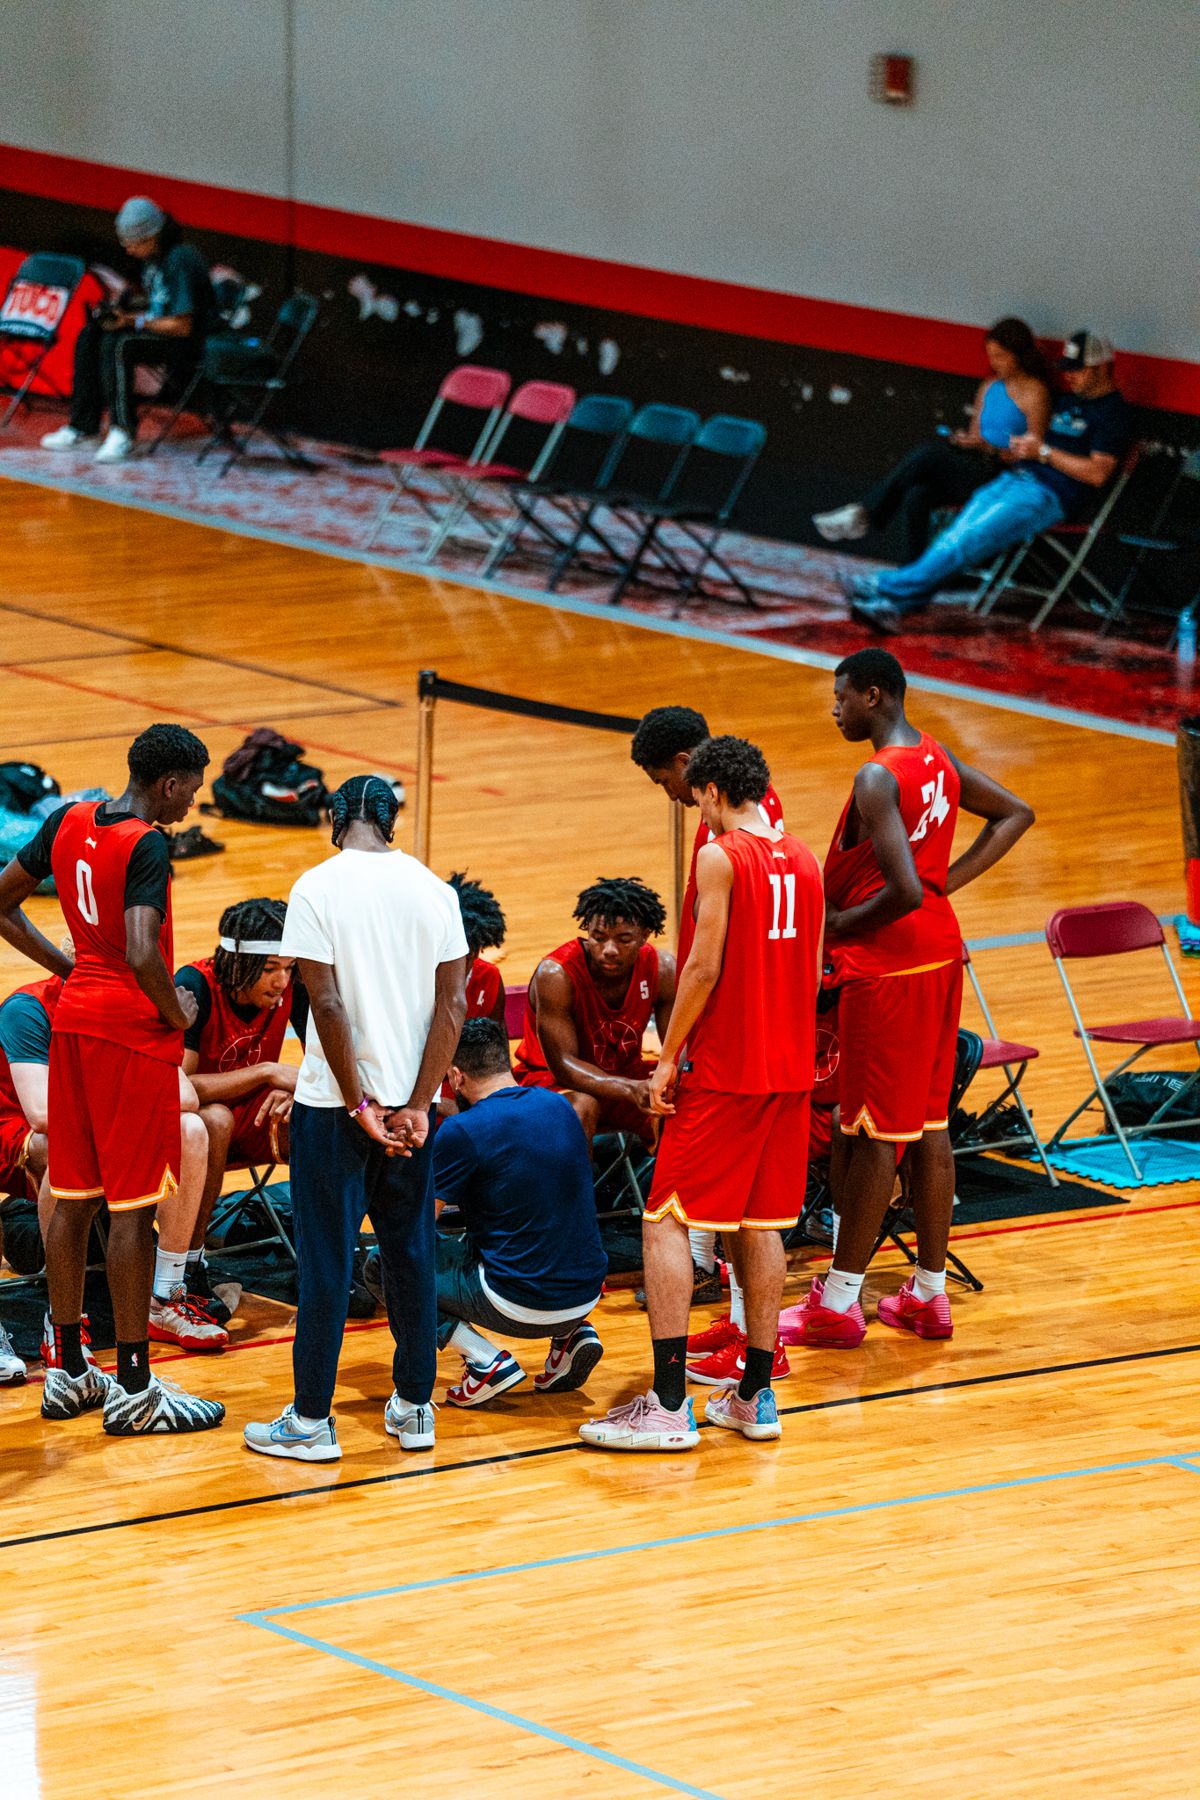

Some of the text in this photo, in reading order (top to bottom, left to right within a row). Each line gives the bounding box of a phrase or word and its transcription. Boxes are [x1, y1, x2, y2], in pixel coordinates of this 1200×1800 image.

[76, 859, 98, 925] 0
[768, 873, 796, 939] 11
[640, 980, 649, 999] 5
